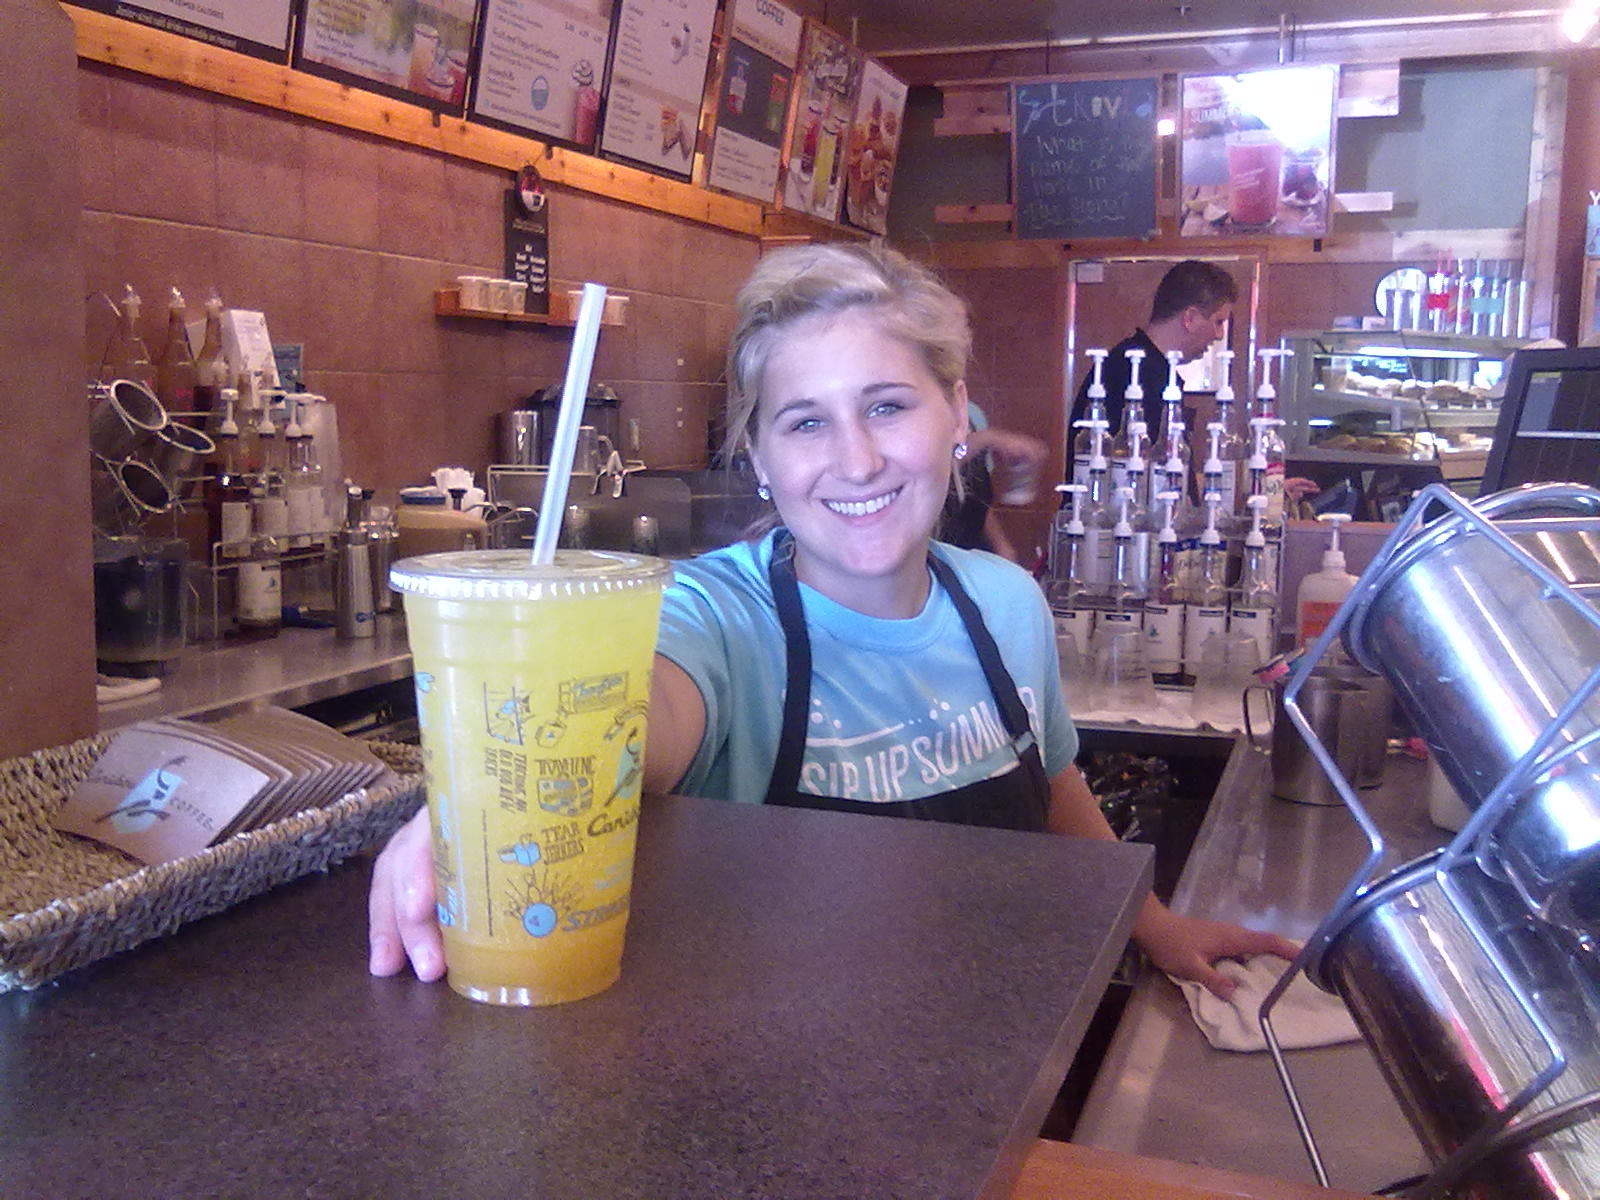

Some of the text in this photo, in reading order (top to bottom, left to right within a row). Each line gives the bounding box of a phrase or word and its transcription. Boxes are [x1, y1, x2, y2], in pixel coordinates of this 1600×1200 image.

[801, 686, 1041, 803] SIP UP SUMMR
